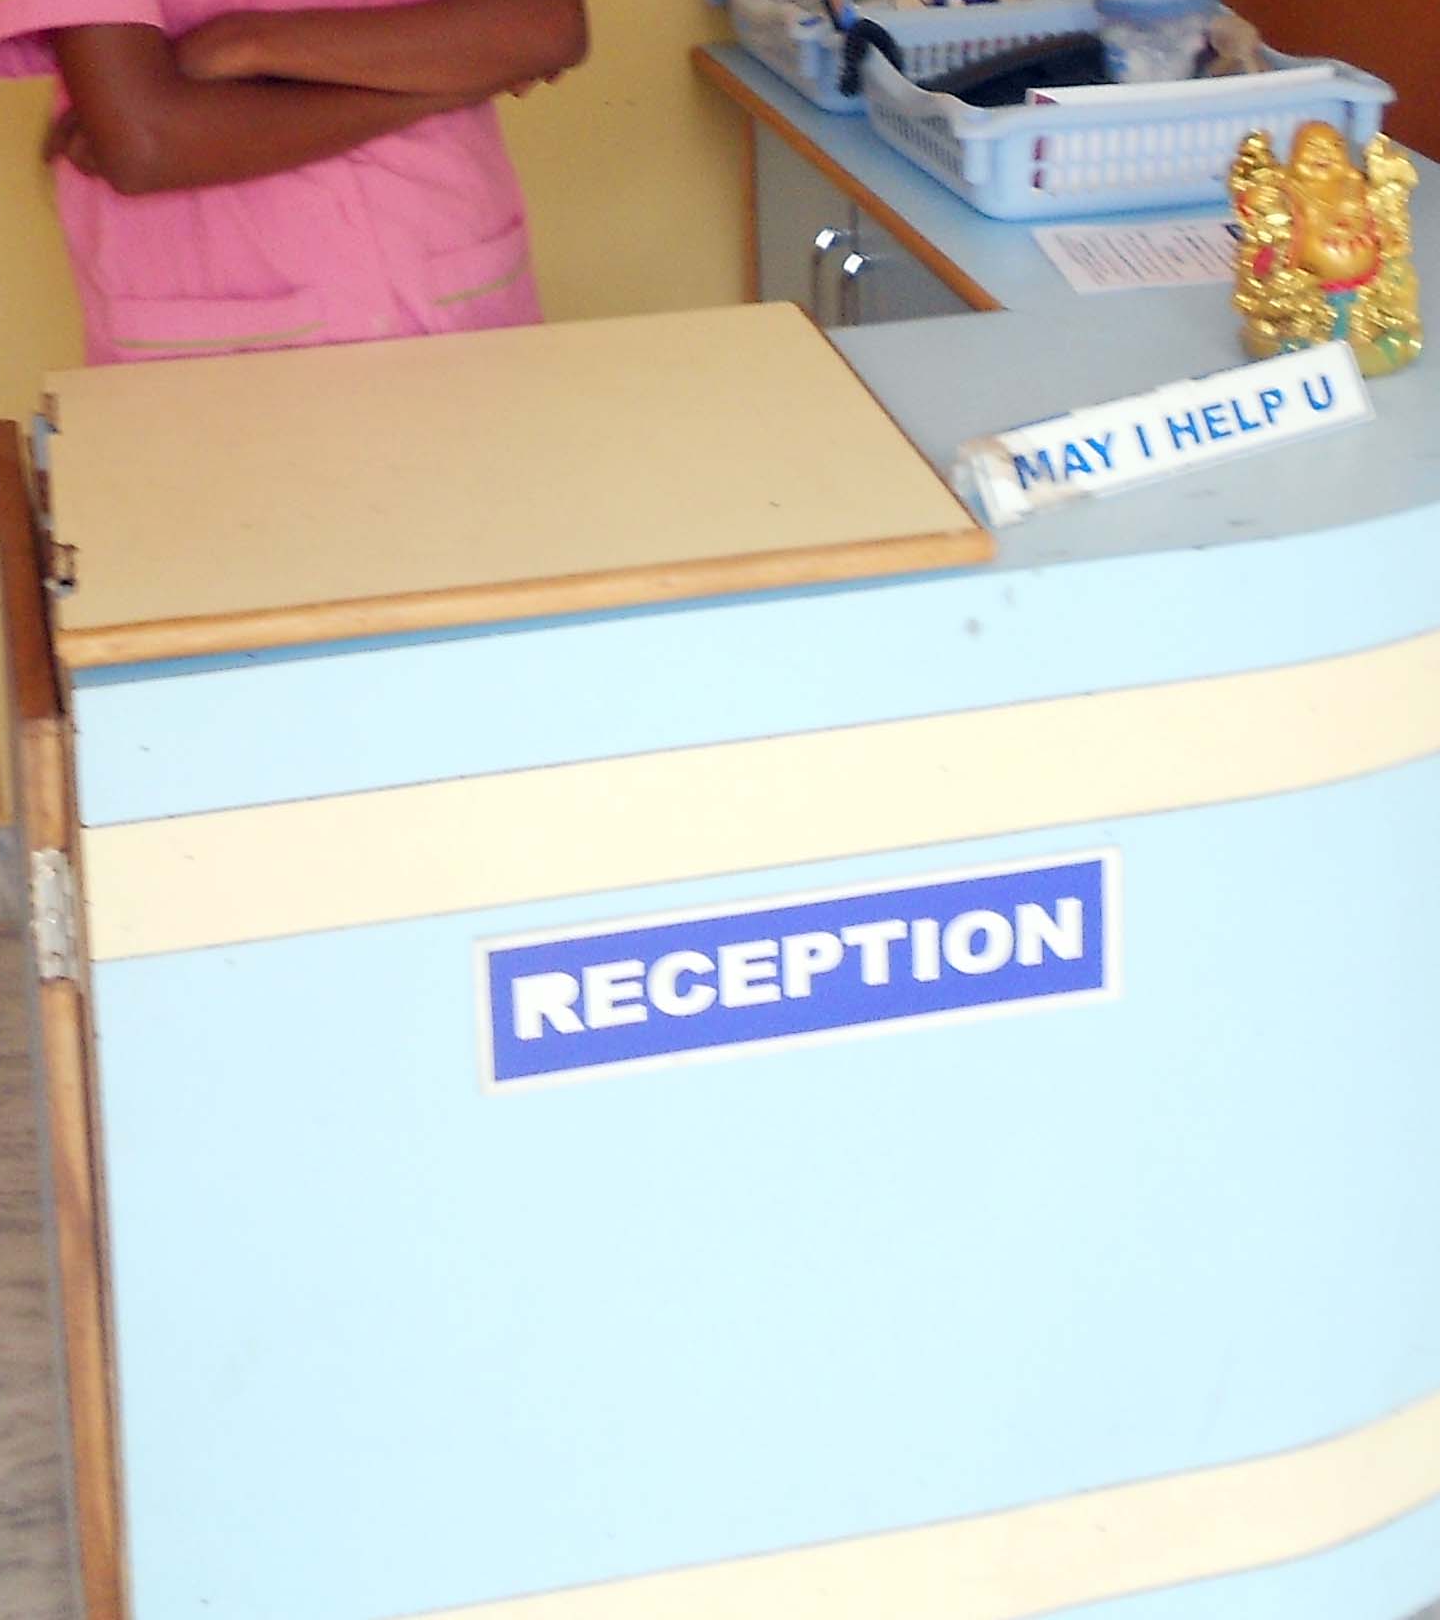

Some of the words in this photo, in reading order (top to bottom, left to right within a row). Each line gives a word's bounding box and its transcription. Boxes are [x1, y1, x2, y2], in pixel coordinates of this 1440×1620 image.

[1013, 431, 1114, 494] MAY
[1138, 423, 1151, 458] I
[1167, 386, 1289, 452] HELP
[1303, 374, 1336, 412] U
[511, 896, 1083, 1040] RECEPTION
